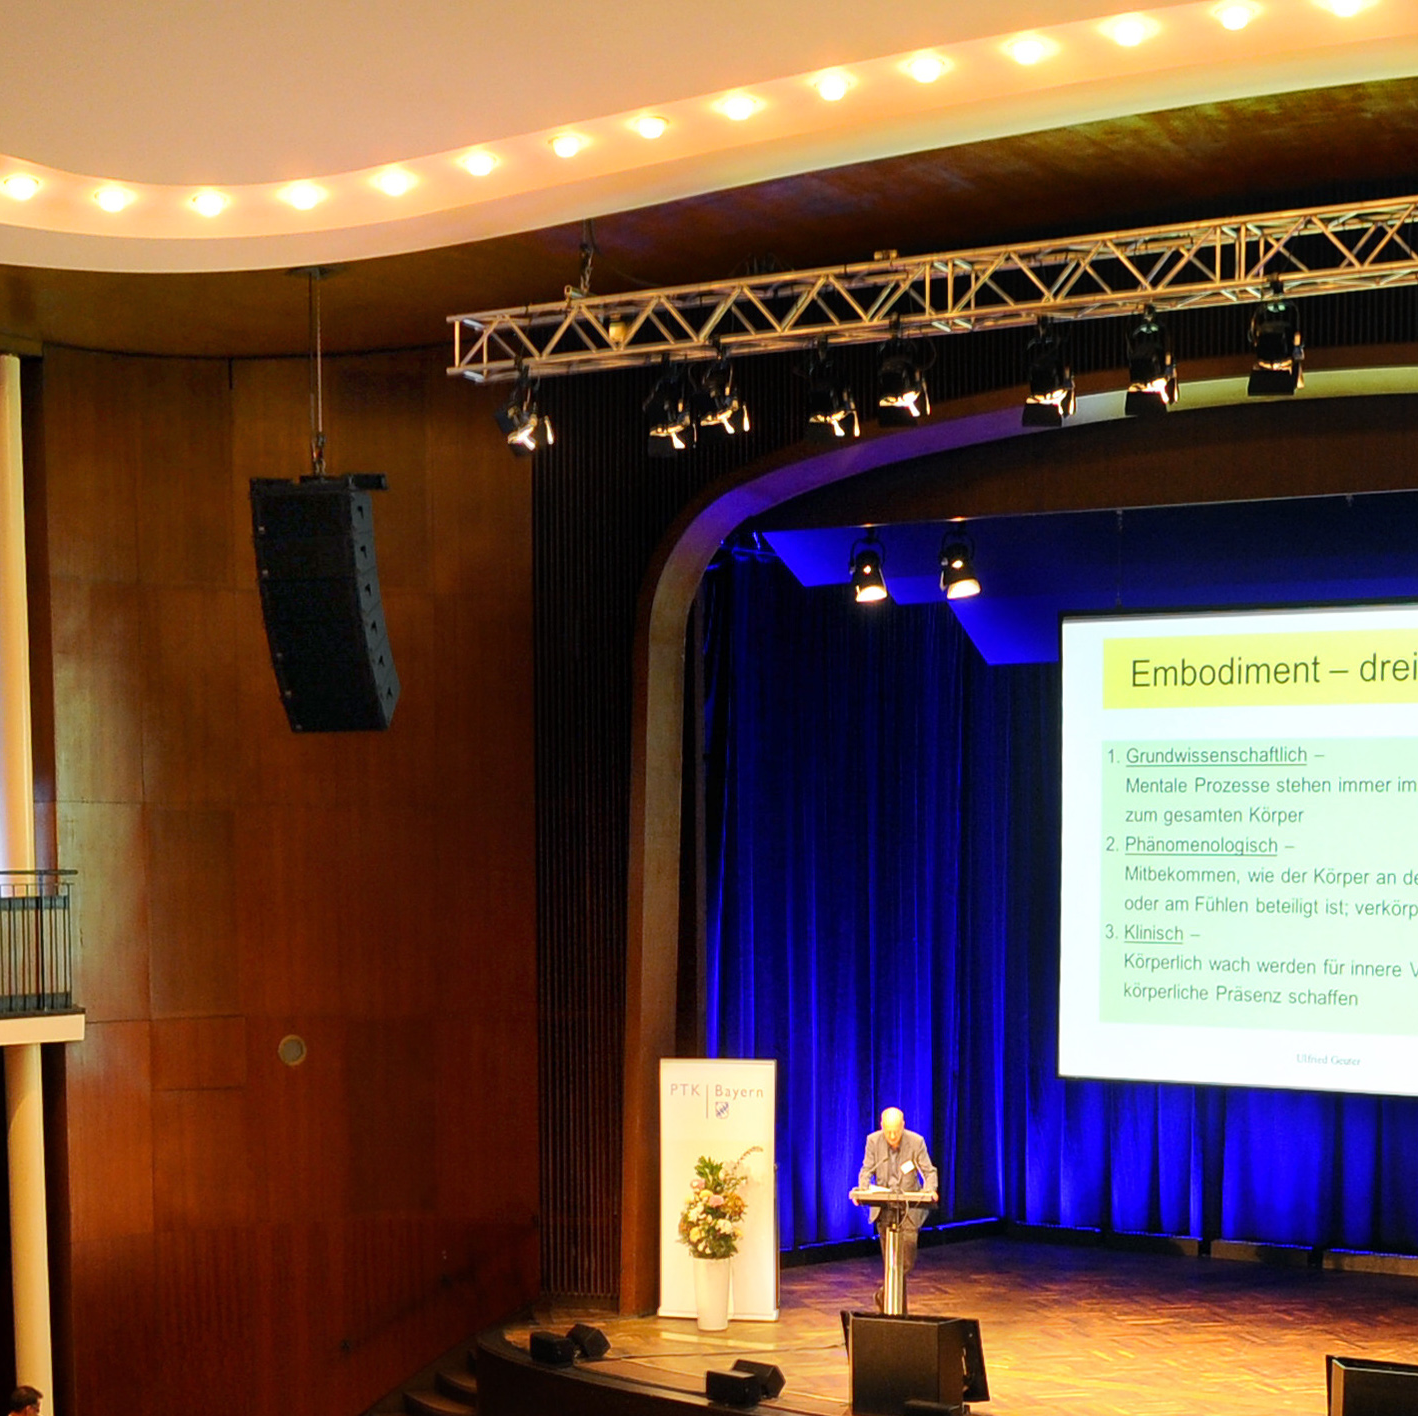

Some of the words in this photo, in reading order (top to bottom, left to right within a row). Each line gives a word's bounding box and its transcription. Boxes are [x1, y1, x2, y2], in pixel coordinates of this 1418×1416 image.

[1132, 655, 1321, 688] Embodiment
[1359, 651, 1418, 683] drei
[1107, 749, 1121, 764] 1.
[1126, 745, 1308, 764] Grundwissenschaftlich
[1126, 777, 1188, 794] Mentale
[1194, 776, 1270, 794] Prozesse
[1276, 776, 1332, 793] stehen
[1338, 776, 1392, 793] immer
[1397, 775, 1417, 793] im
[1125, 809, 1158, 823] zum
[1163, 807, 1243, 827] gesamten
[1249, 806, 1304, 827] Körper
[1105, 835, 1119, 852] 2.
[1125, 836, 1278, 856] Phänomenologisch
[1124, 865, 1240, 885] Mitbekommen,
[1248, 867, 1274, 883] wie
[1280, 866, 1308, 884] der
[1313, 867, 1370, 889] Körper
[1375, 872, 1397, 885] an
[1124, 895, 1160, 912] oder
[1164, 898, 1189, 912] am
[1195, 895, 1249, 913] Fühlen
[1255, 897, 1319, 919] beteiligt
[1325, 898, 1349, 918] ist;
[1105, 924, 1118, 940] 3.
[1125, 924, 1183, 940] Klinisch
[1124, 952, 1203, 973] Körperlich
[1208, 956, 1249, 973] wach
[1256, 958, 1317, 975] werden
[1323, 958, 1346, 976] für
[1350, 960, 1402, 978] innere
[1123, 982, 1209, 1003] körperliche
[1215, 984, 1282, 1004] Präsenz
[1288, 988, 1359, 1006] schaffen
[670, 1082, 702, 1097] PTK
[714, 1083, 764, 1101] Bayern
